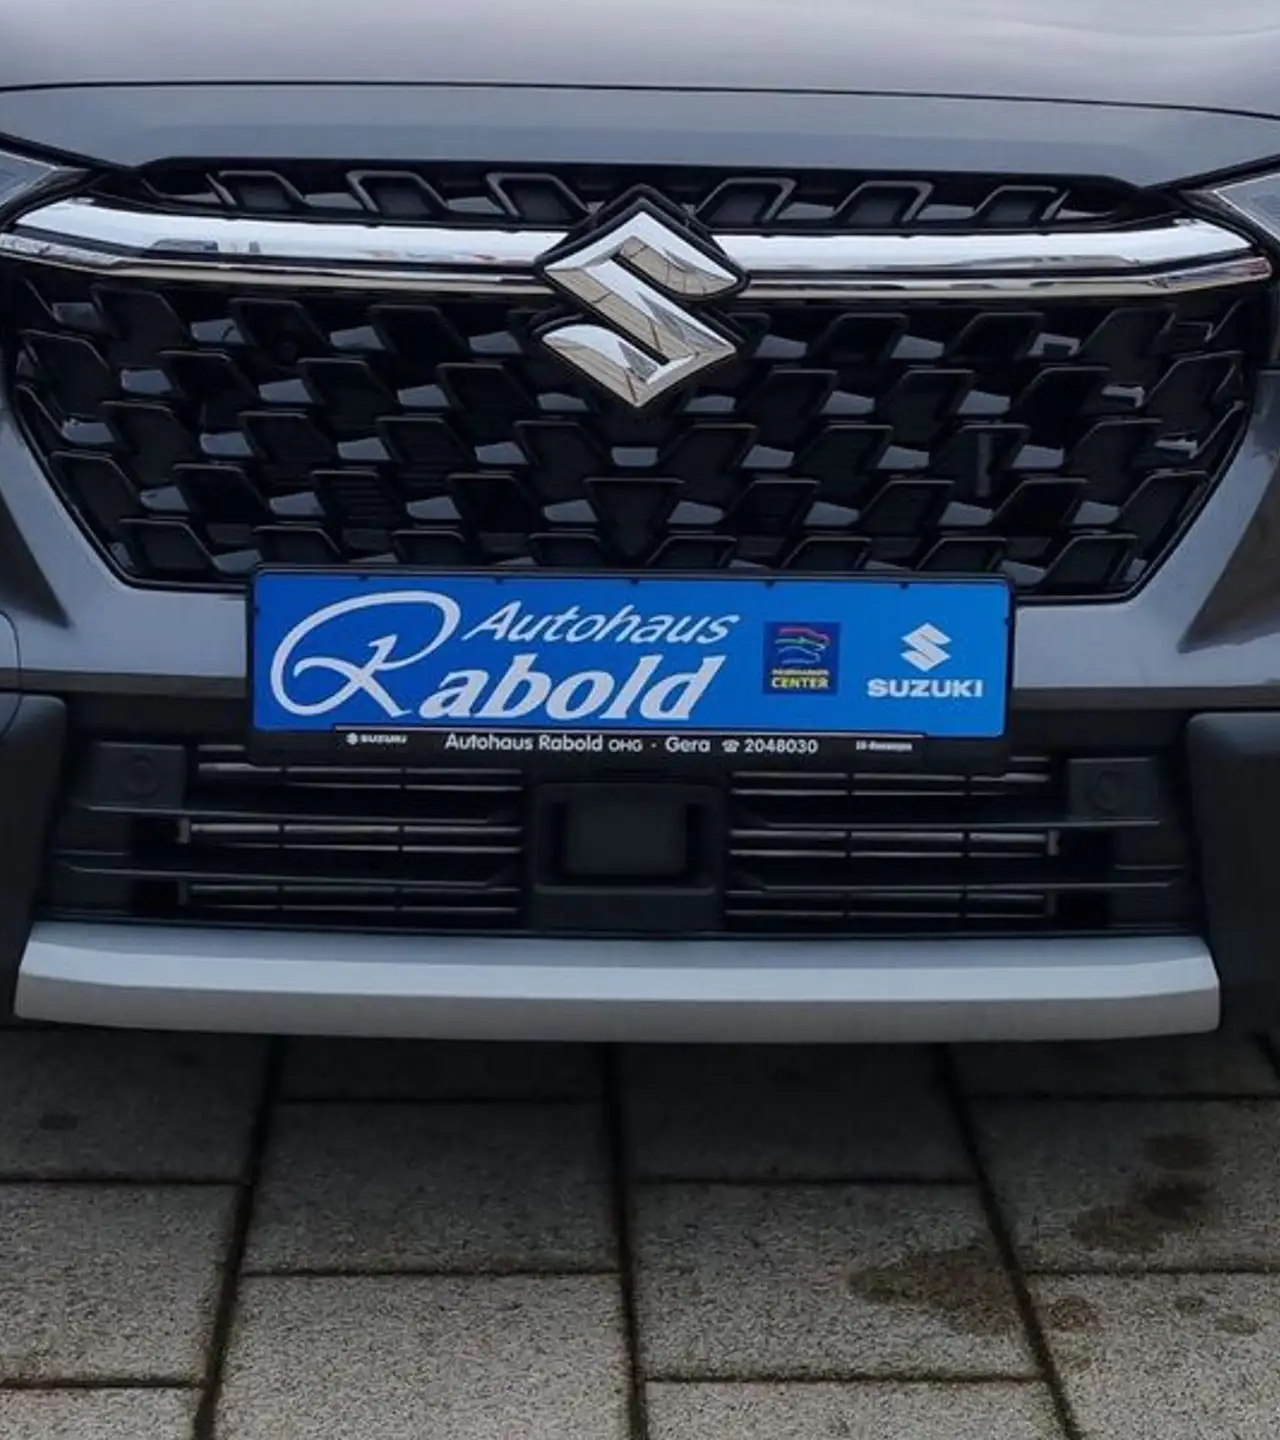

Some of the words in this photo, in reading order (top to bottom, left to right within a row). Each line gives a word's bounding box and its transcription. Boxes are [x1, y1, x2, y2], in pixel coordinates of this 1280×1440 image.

[460, 600, 740, 644] Autohaus
[270, 590, 727, 720] Rabold
[771, 676, 829, 689] CENTER
[867, 678, 984, 698] SUZUKI
[444, 732, 534, 751] Autohaus
[538, 734, 603, 752] Rabold
[608, 739, 643, 752] OHG
[664, 735, 711, 753] Gera
[743, 738, 819, 754] 2048030
